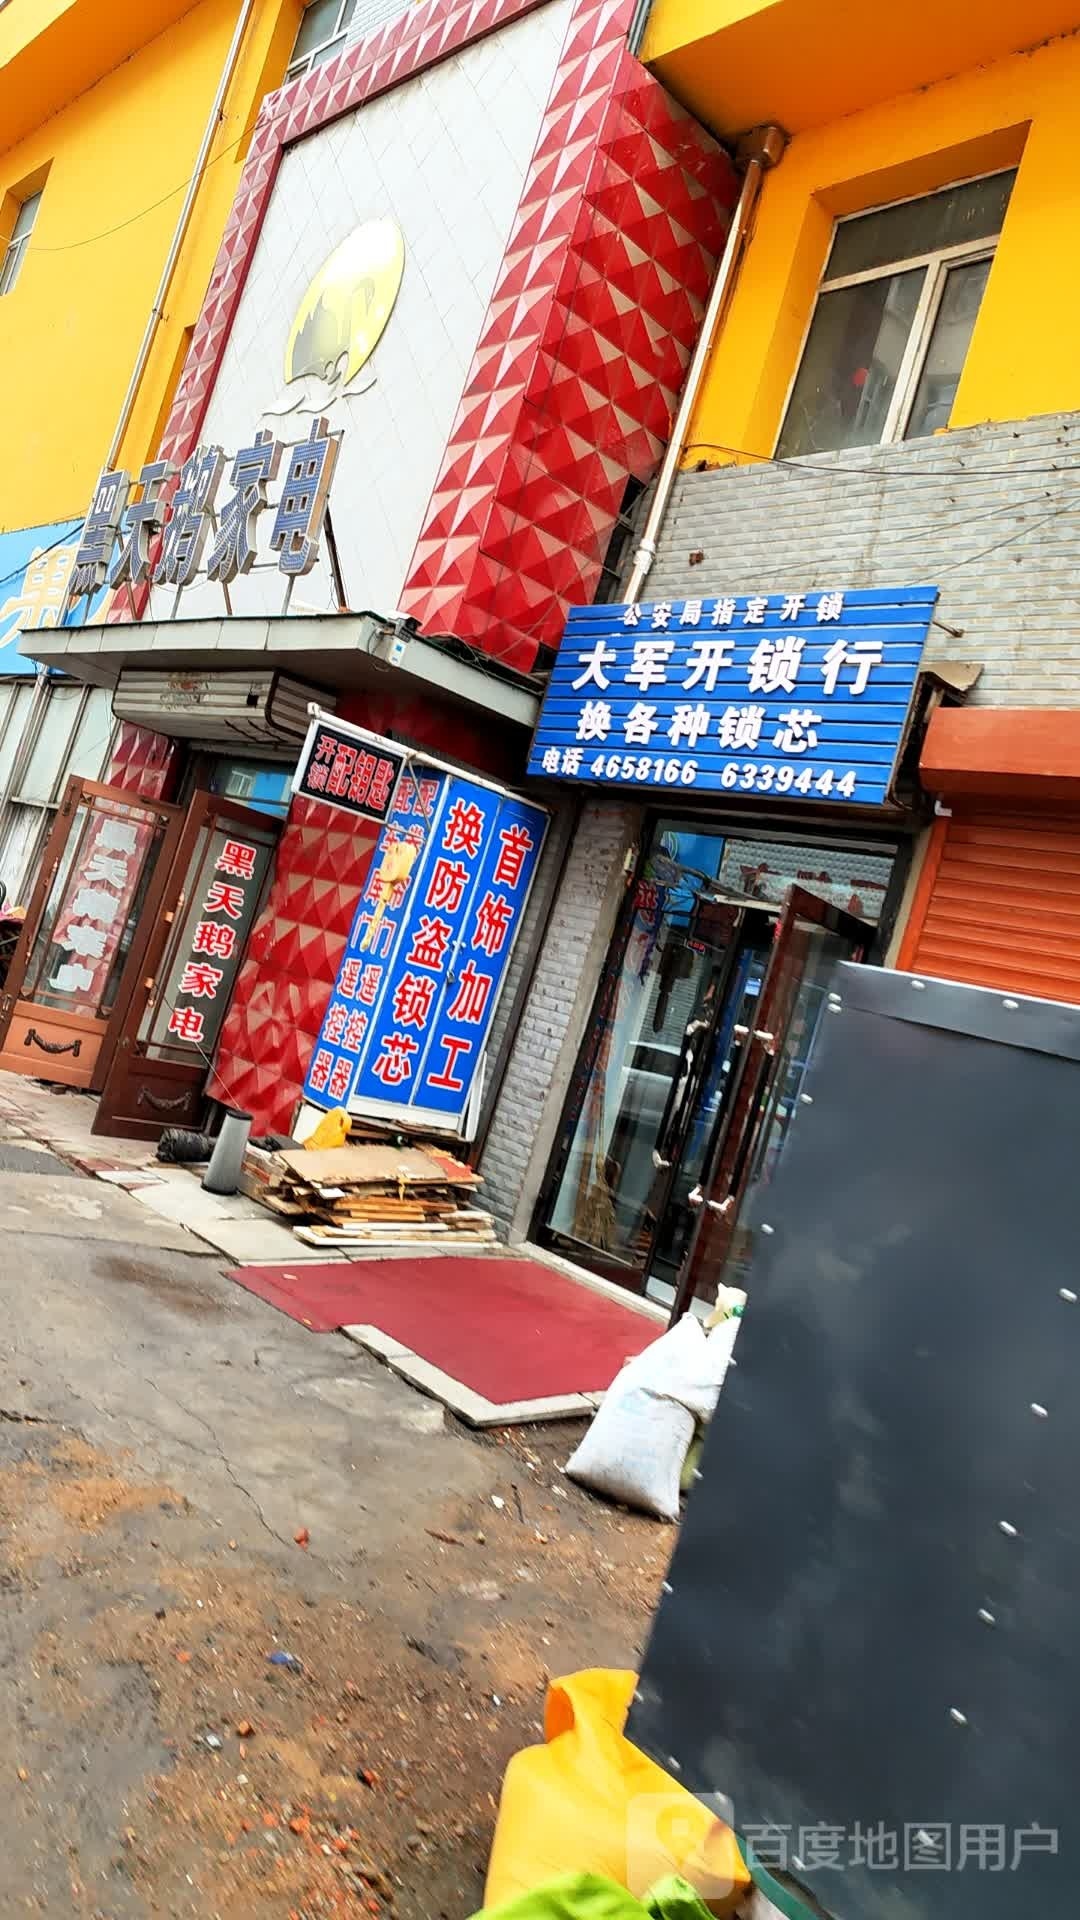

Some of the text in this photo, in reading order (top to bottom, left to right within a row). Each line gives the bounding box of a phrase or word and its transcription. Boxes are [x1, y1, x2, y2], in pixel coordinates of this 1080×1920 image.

[623, 592, 844, 629] 公安局指定开锁
[571, 635, 883, 696] 大军开锁行
[575, 701, 823, 754] 换各种锁芯
[541, 747, 858, 798] 电话 4658166 6339444
[168, 839, 257, 1043] 黑天鹅家电
[372, 797, 486, 1090] 换防盗锁芯
[427, 823, 534, 1092] 首饰加工
